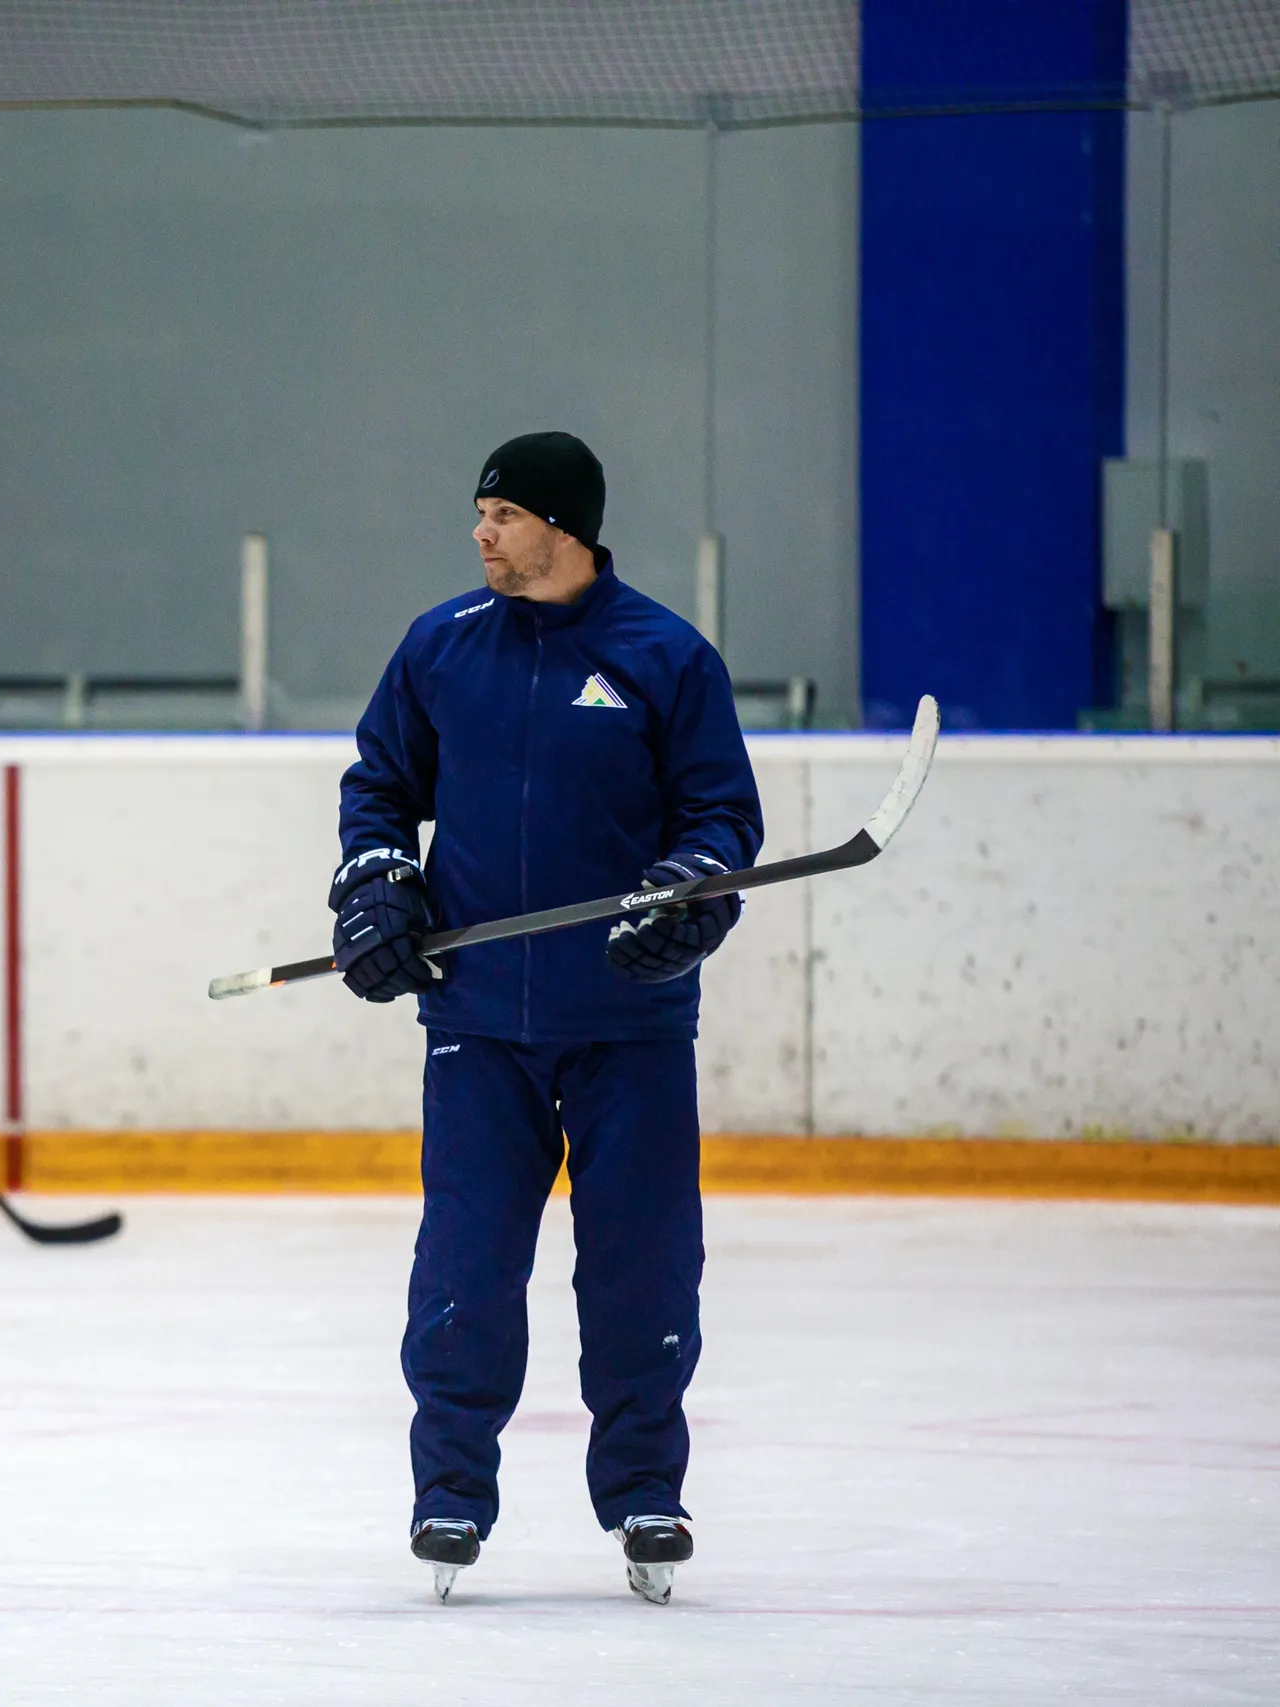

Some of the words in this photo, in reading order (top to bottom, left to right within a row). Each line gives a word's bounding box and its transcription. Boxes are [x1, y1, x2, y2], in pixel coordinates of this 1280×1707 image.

[453, 597, 495, 618] CCM
[334, 847, 427, 885] TRU
[629, 889, 675, 905] EASTON
[431, 1043, 461, 1056] CCM
